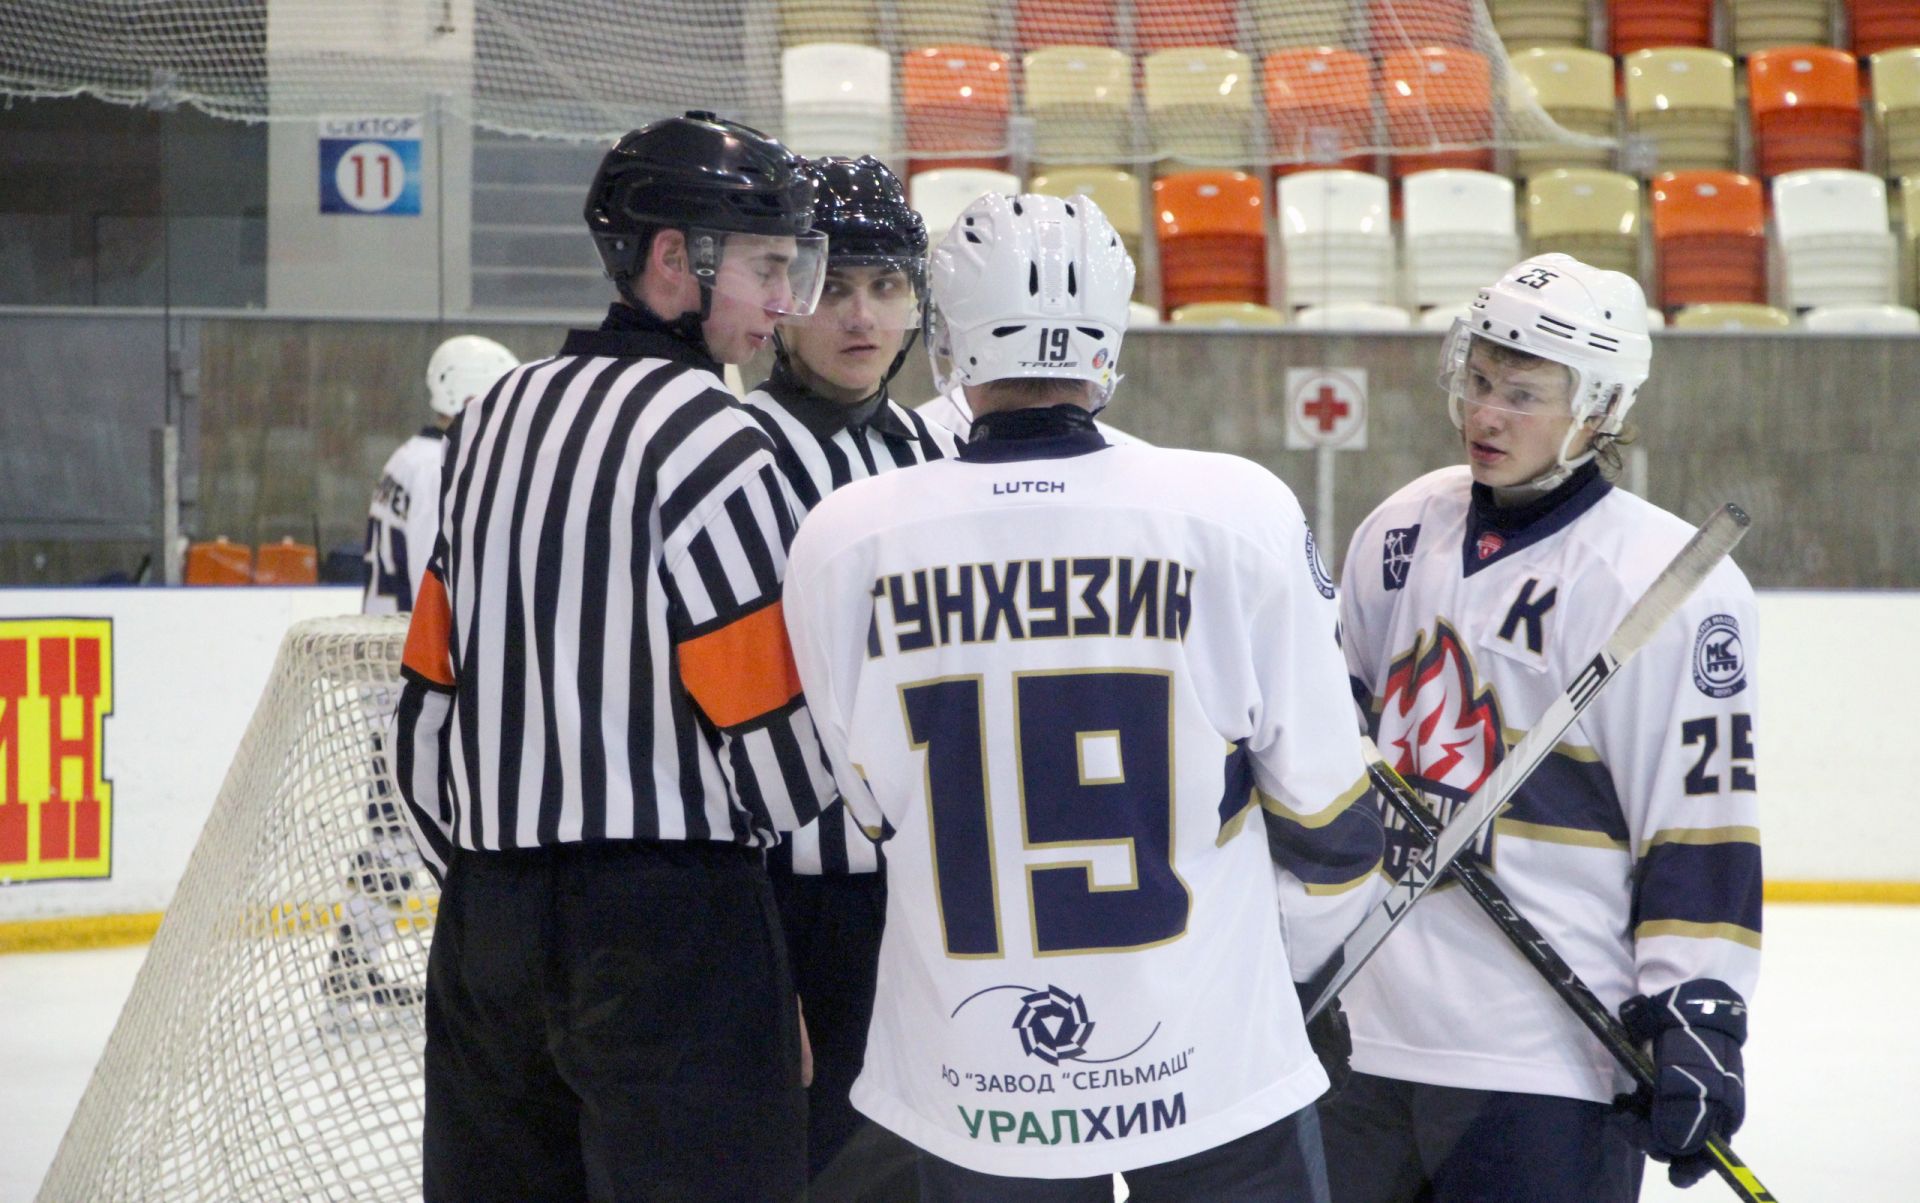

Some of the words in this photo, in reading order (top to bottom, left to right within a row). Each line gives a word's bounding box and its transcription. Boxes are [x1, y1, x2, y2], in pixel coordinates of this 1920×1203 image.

[350, 154, 391, 199] 11
[1516, 268, 1560, 290] 25
[1038, 327, 1070, 361] 19
[993, 481, 1065, 495] LUTCH
[1681, 713, 1757, 796] 25
[897, 667, 1193, 960] 19
[942, 1064, 960, 1087] АО
[957, 1091, 1187, 1145] УРАЛХИМ
